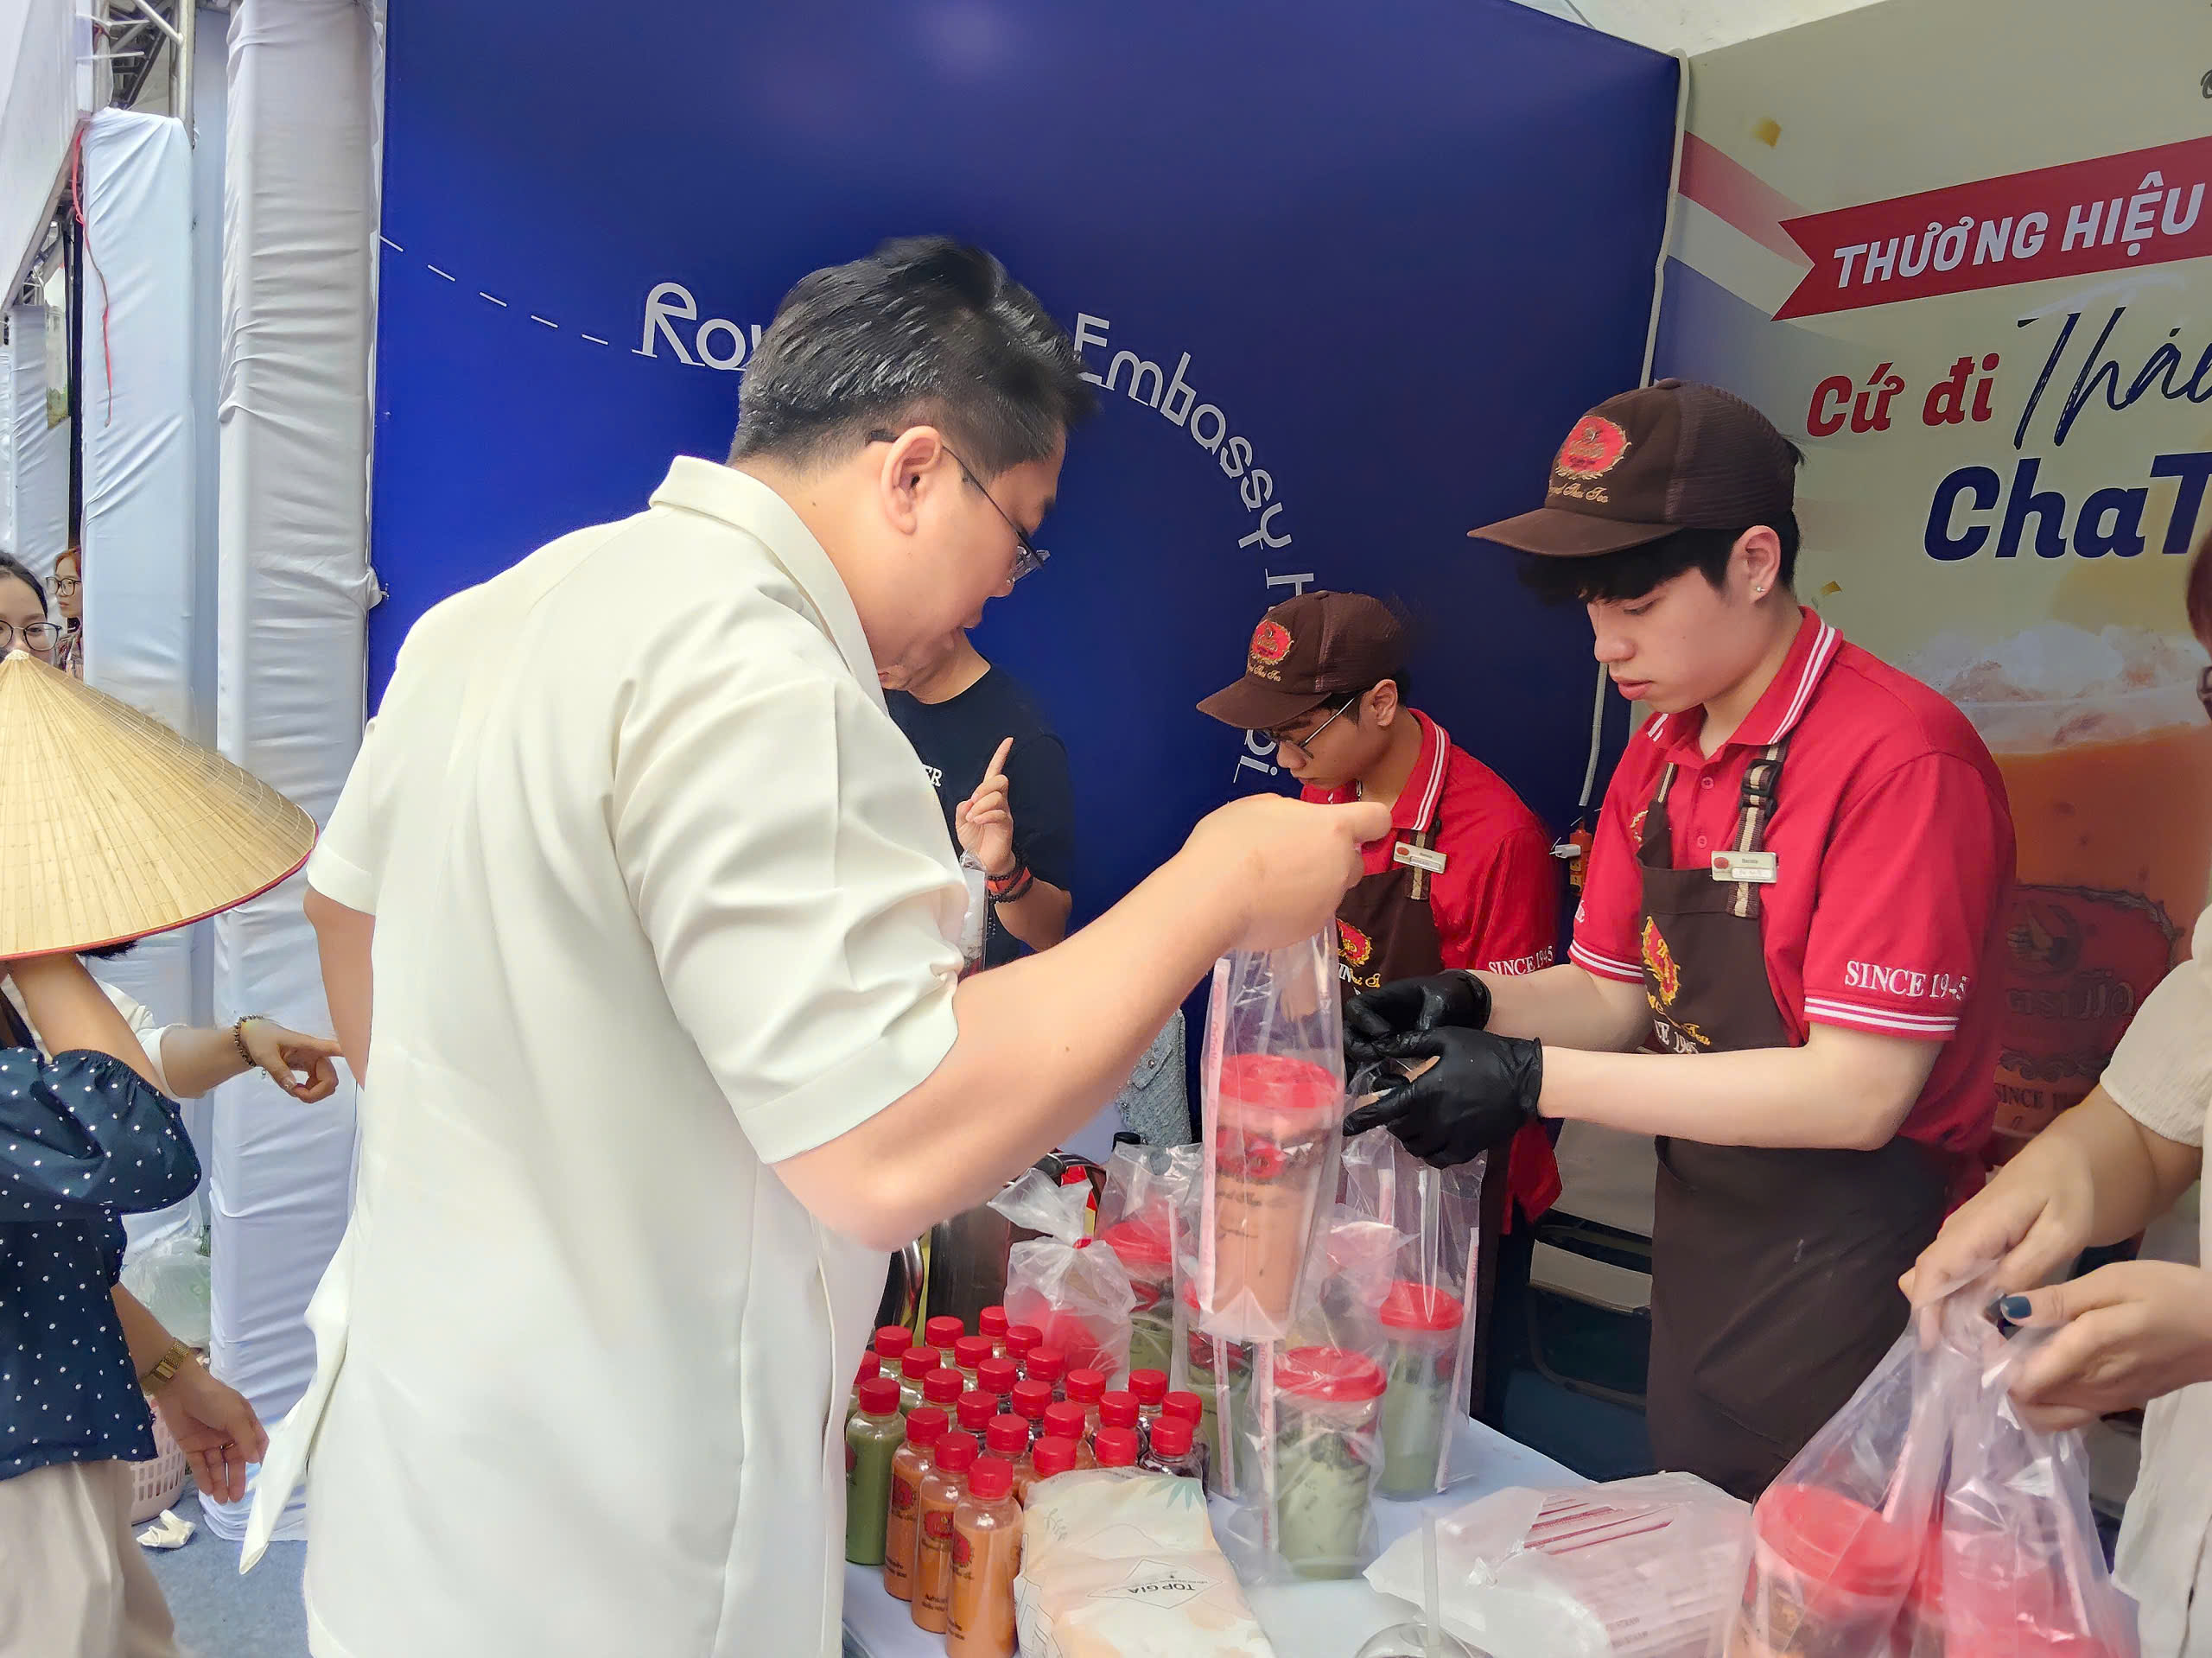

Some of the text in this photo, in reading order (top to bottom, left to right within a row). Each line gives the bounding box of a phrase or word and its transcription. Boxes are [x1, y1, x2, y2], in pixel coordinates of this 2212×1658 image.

[1833, 170, 2206, 289] THƯƠNG HIỆU
[1073, 312, 1293, 549] Embassy
[1807, 361, 1905, 438] Cứ
[1922, 353, 1999, 427] đi
[1845, 960, 1926, 997] SINCE
[1127, 1583, 1196, 1595] TOP GIA
